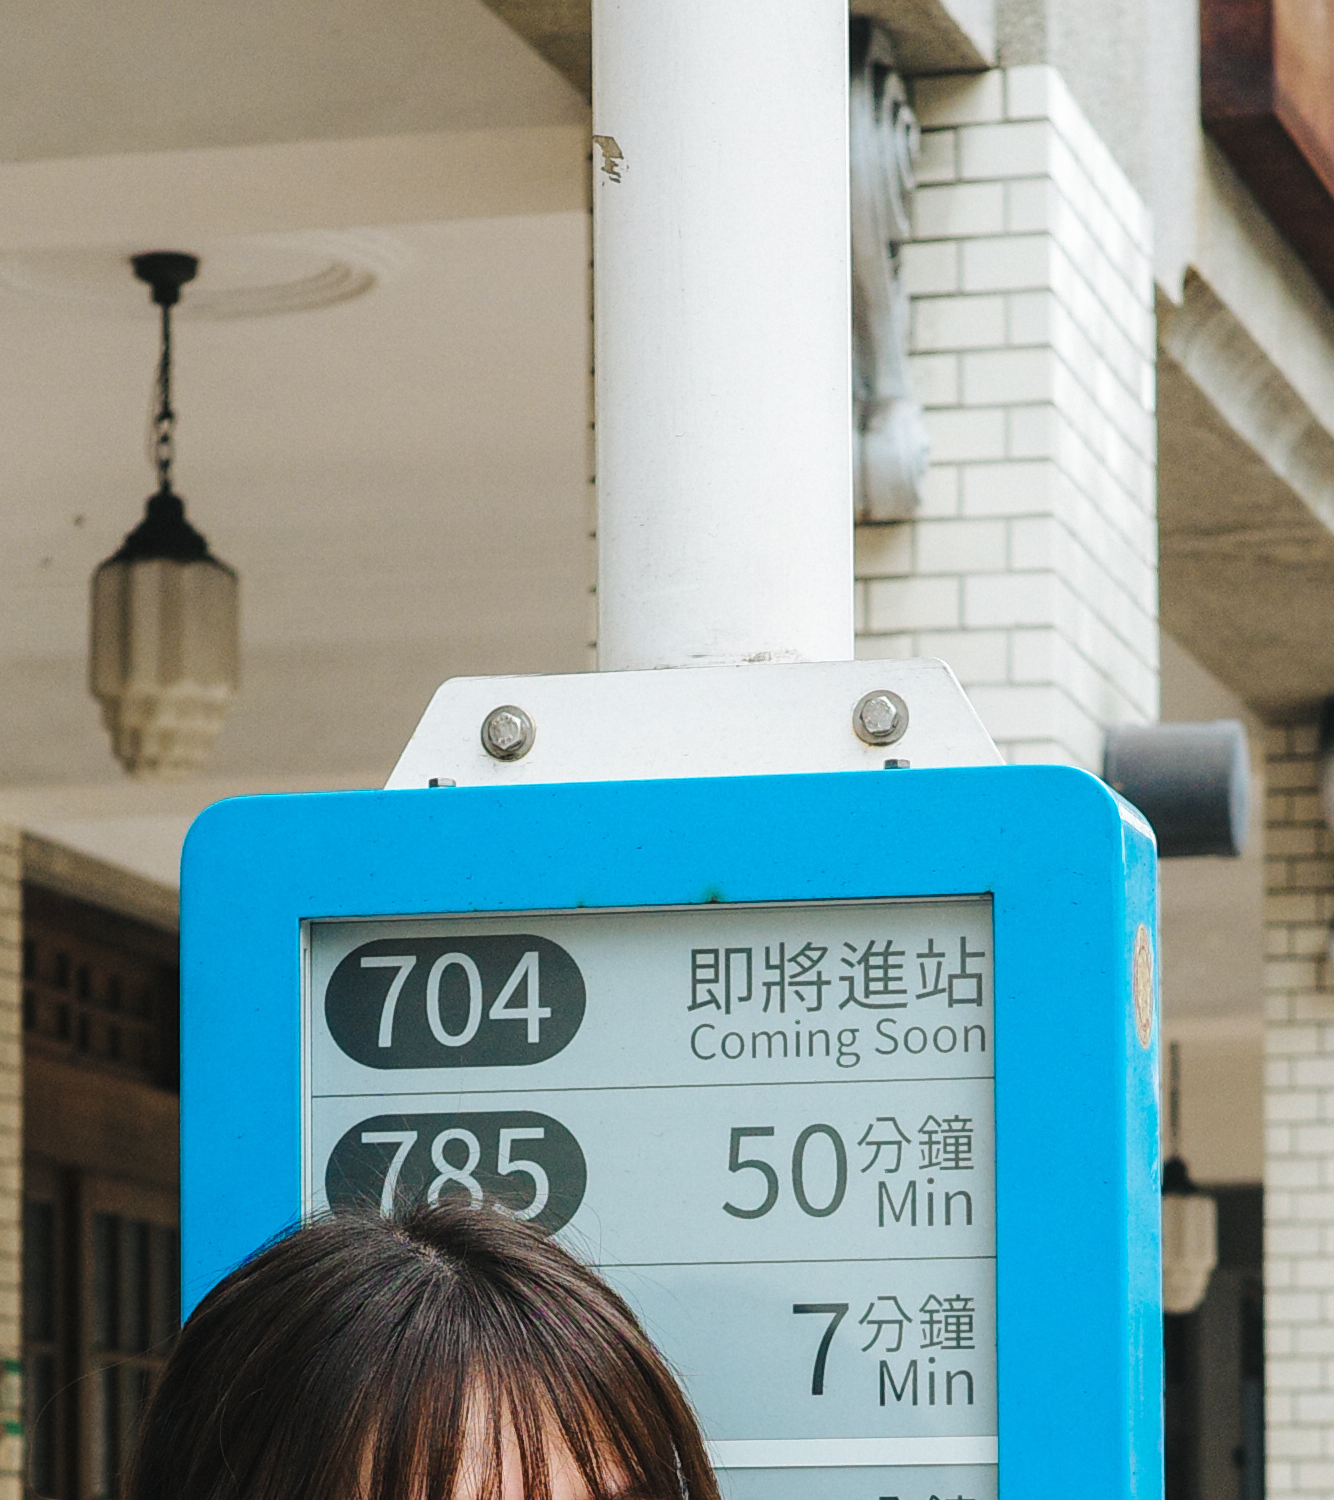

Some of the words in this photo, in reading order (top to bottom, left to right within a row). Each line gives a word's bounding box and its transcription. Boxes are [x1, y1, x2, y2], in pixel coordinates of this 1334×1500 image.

[360, 951, 552, 1048] 704
[686, 936, 986, 1015] 即將進站
[690, 1018, 861, 1069] Coming
[874, 1017, 986, 1055] Soon
[360, 1127, 550, 1220] 785
[722, 1123, 848, 1220] 50
[857, 1114, 975, 1175] 分鐘
[878, 1177, 973, 1228] Min
[792, 1302, 850, 1396] 7
[858, 1293, 976, 1353] 分鐘
[879, 1356, 974, 1407] Min
